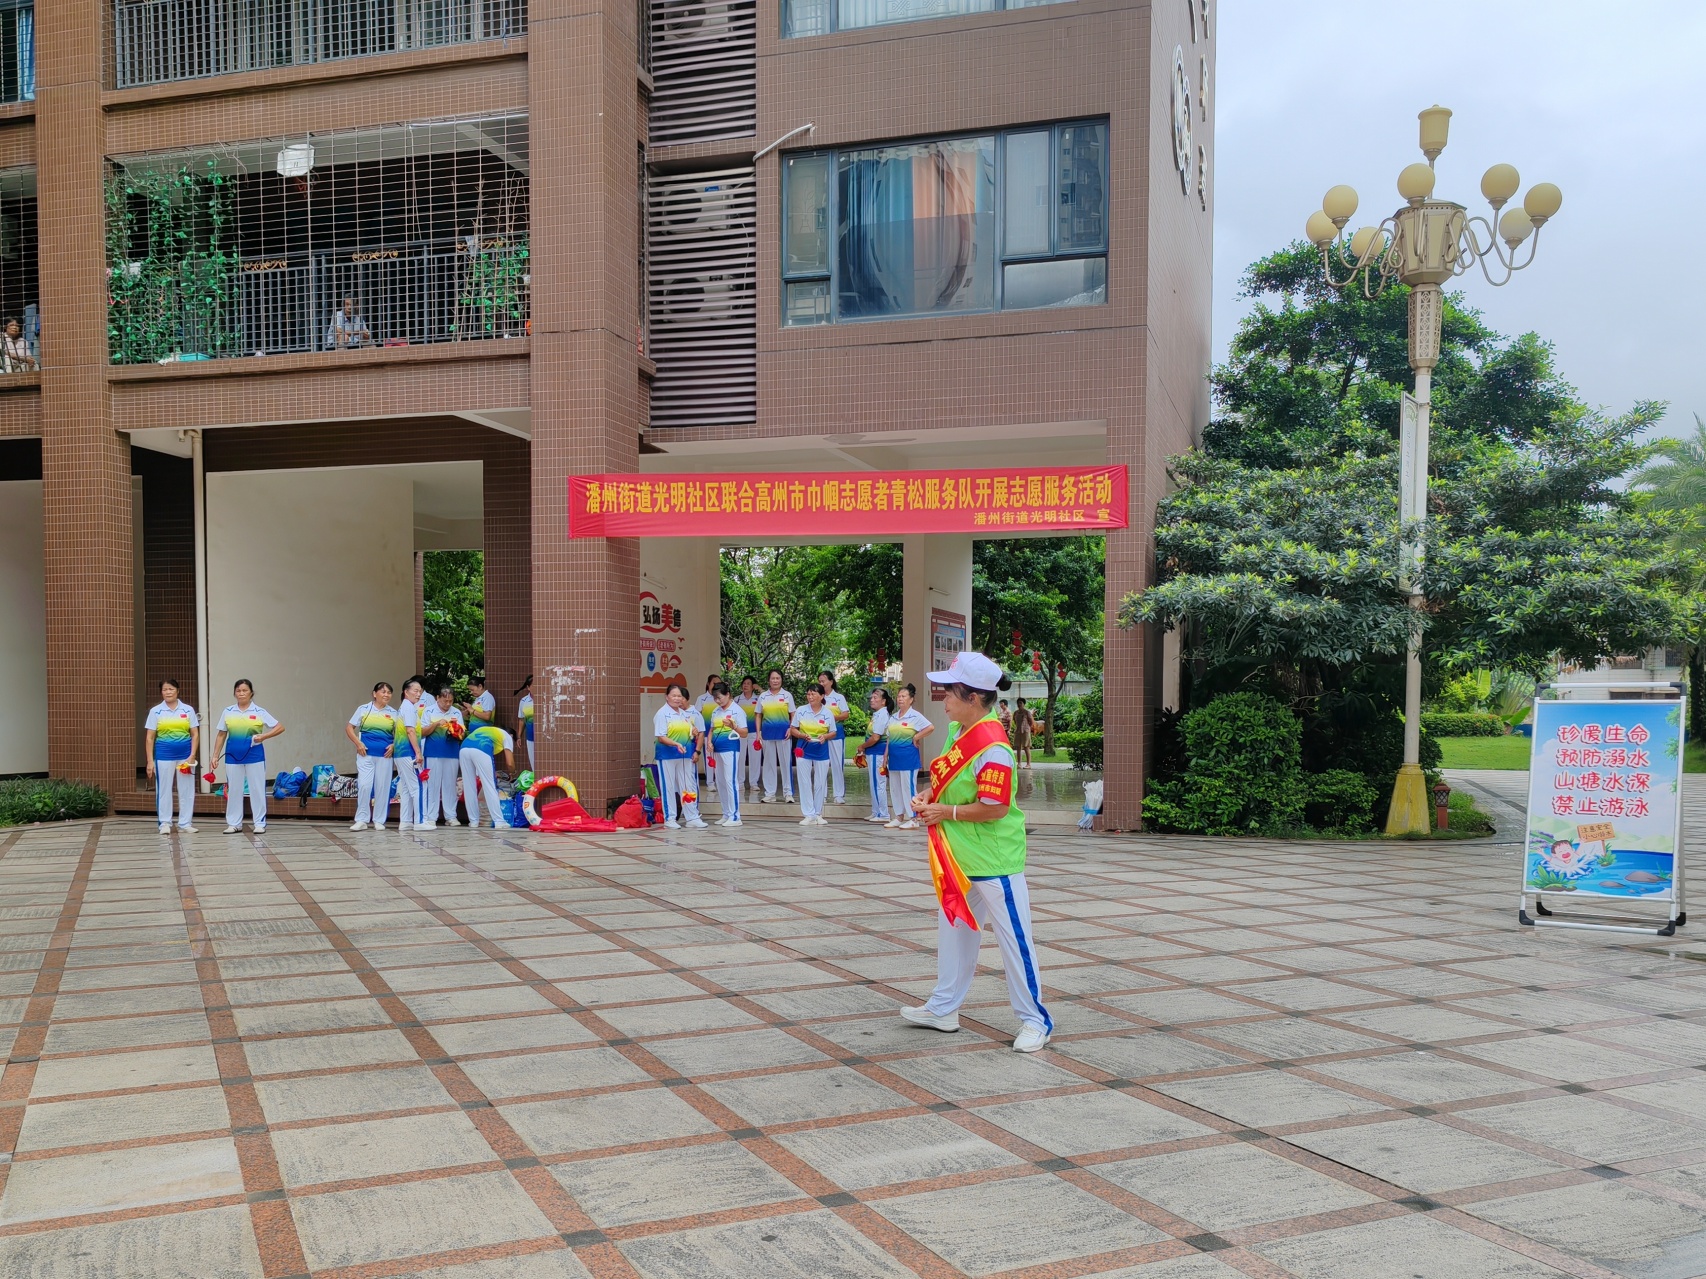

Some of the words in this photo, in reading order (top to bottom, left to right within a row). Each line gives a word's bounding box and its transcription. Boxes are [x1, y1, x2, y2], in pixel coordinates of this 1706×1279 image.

[585, 473, 1112, 513] 潘州街道光明社区联合高州市巾帼志愿者青松服务队开展志愿服务活动
[974, 510, 1085, 525] 潘州街道光明社区
[1097, 508, 1110, 521] 宣
[643, 603, 681, 627] 弘扬美德
[1558, 724, 1649, 744] 珍爱生命
[1557, 748, 1649, 767] 预防溺水
[1555, 771, 1650, 792] 山塘水深
[1552, 795, 1649, 816] 禁止游泳
